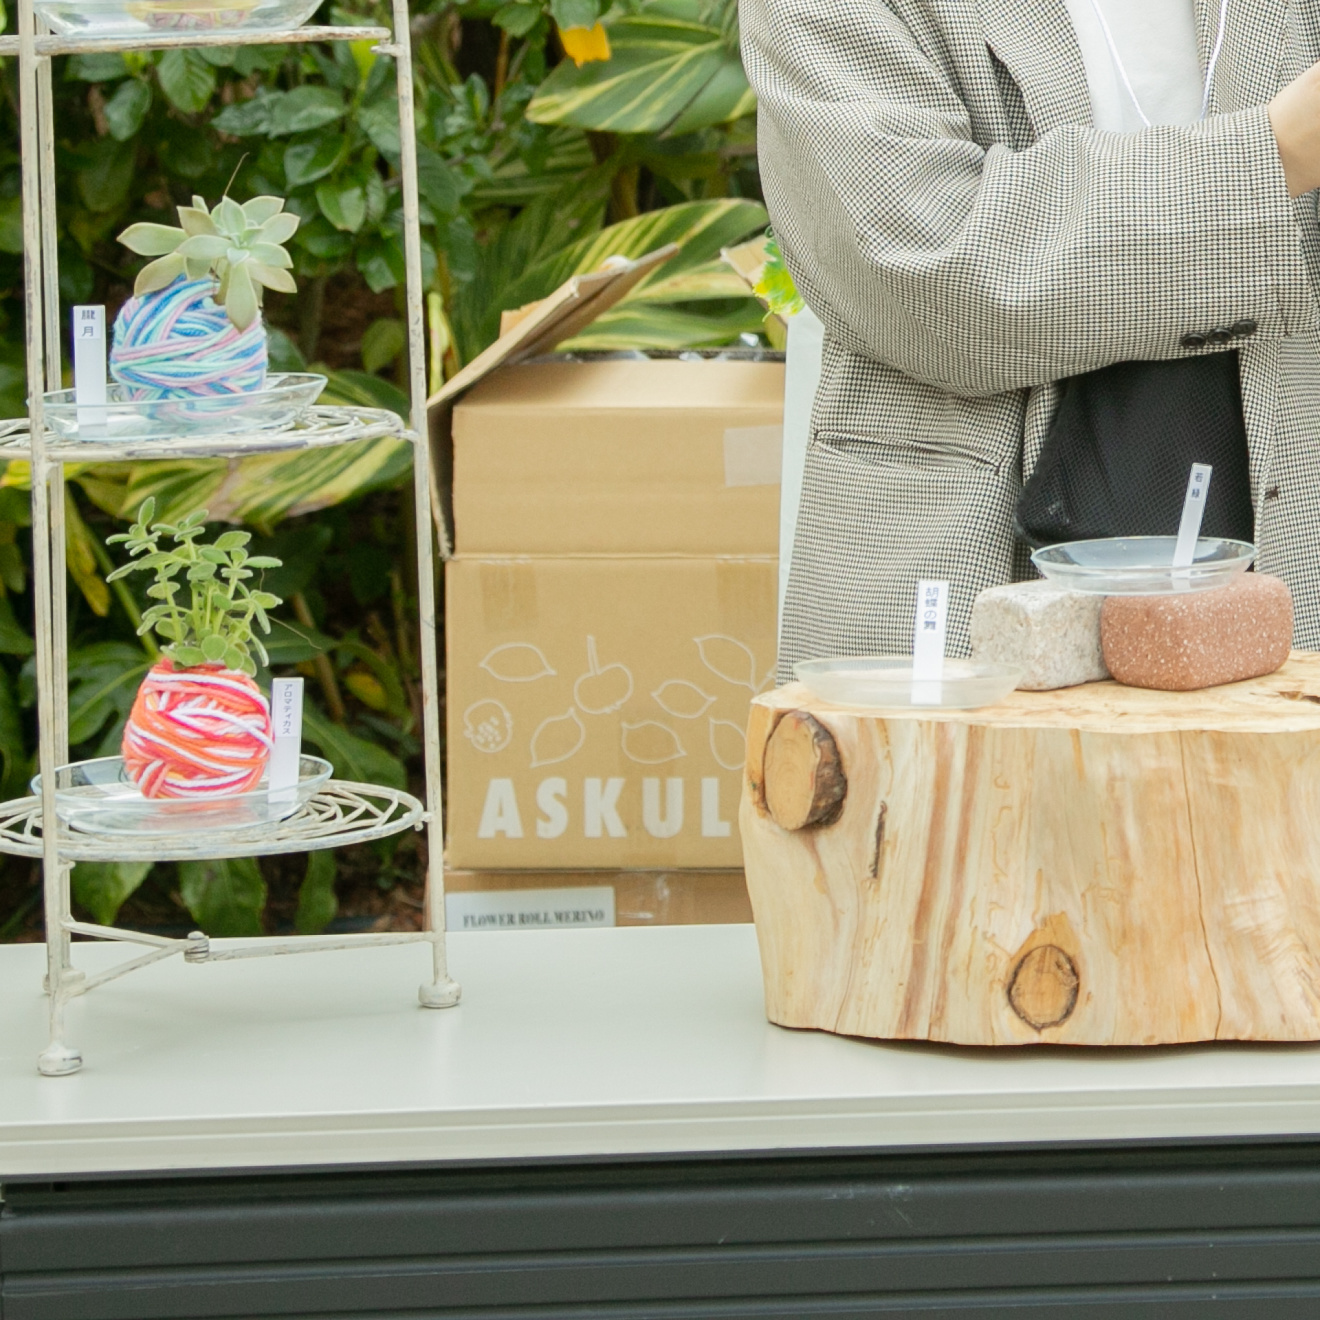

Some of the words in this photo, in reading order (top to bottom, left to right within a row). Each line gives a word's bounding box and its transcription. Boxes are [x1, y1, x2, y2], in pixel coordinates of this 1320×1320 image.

[281, 683, 294, 735] アロマティカス
[476, 775, 732, 840] ASKUL
[463, 912, 515, 929] FLOWER
[518, 910, 552, 927] ROLL
[554, 909, 606, 924] MERINO
